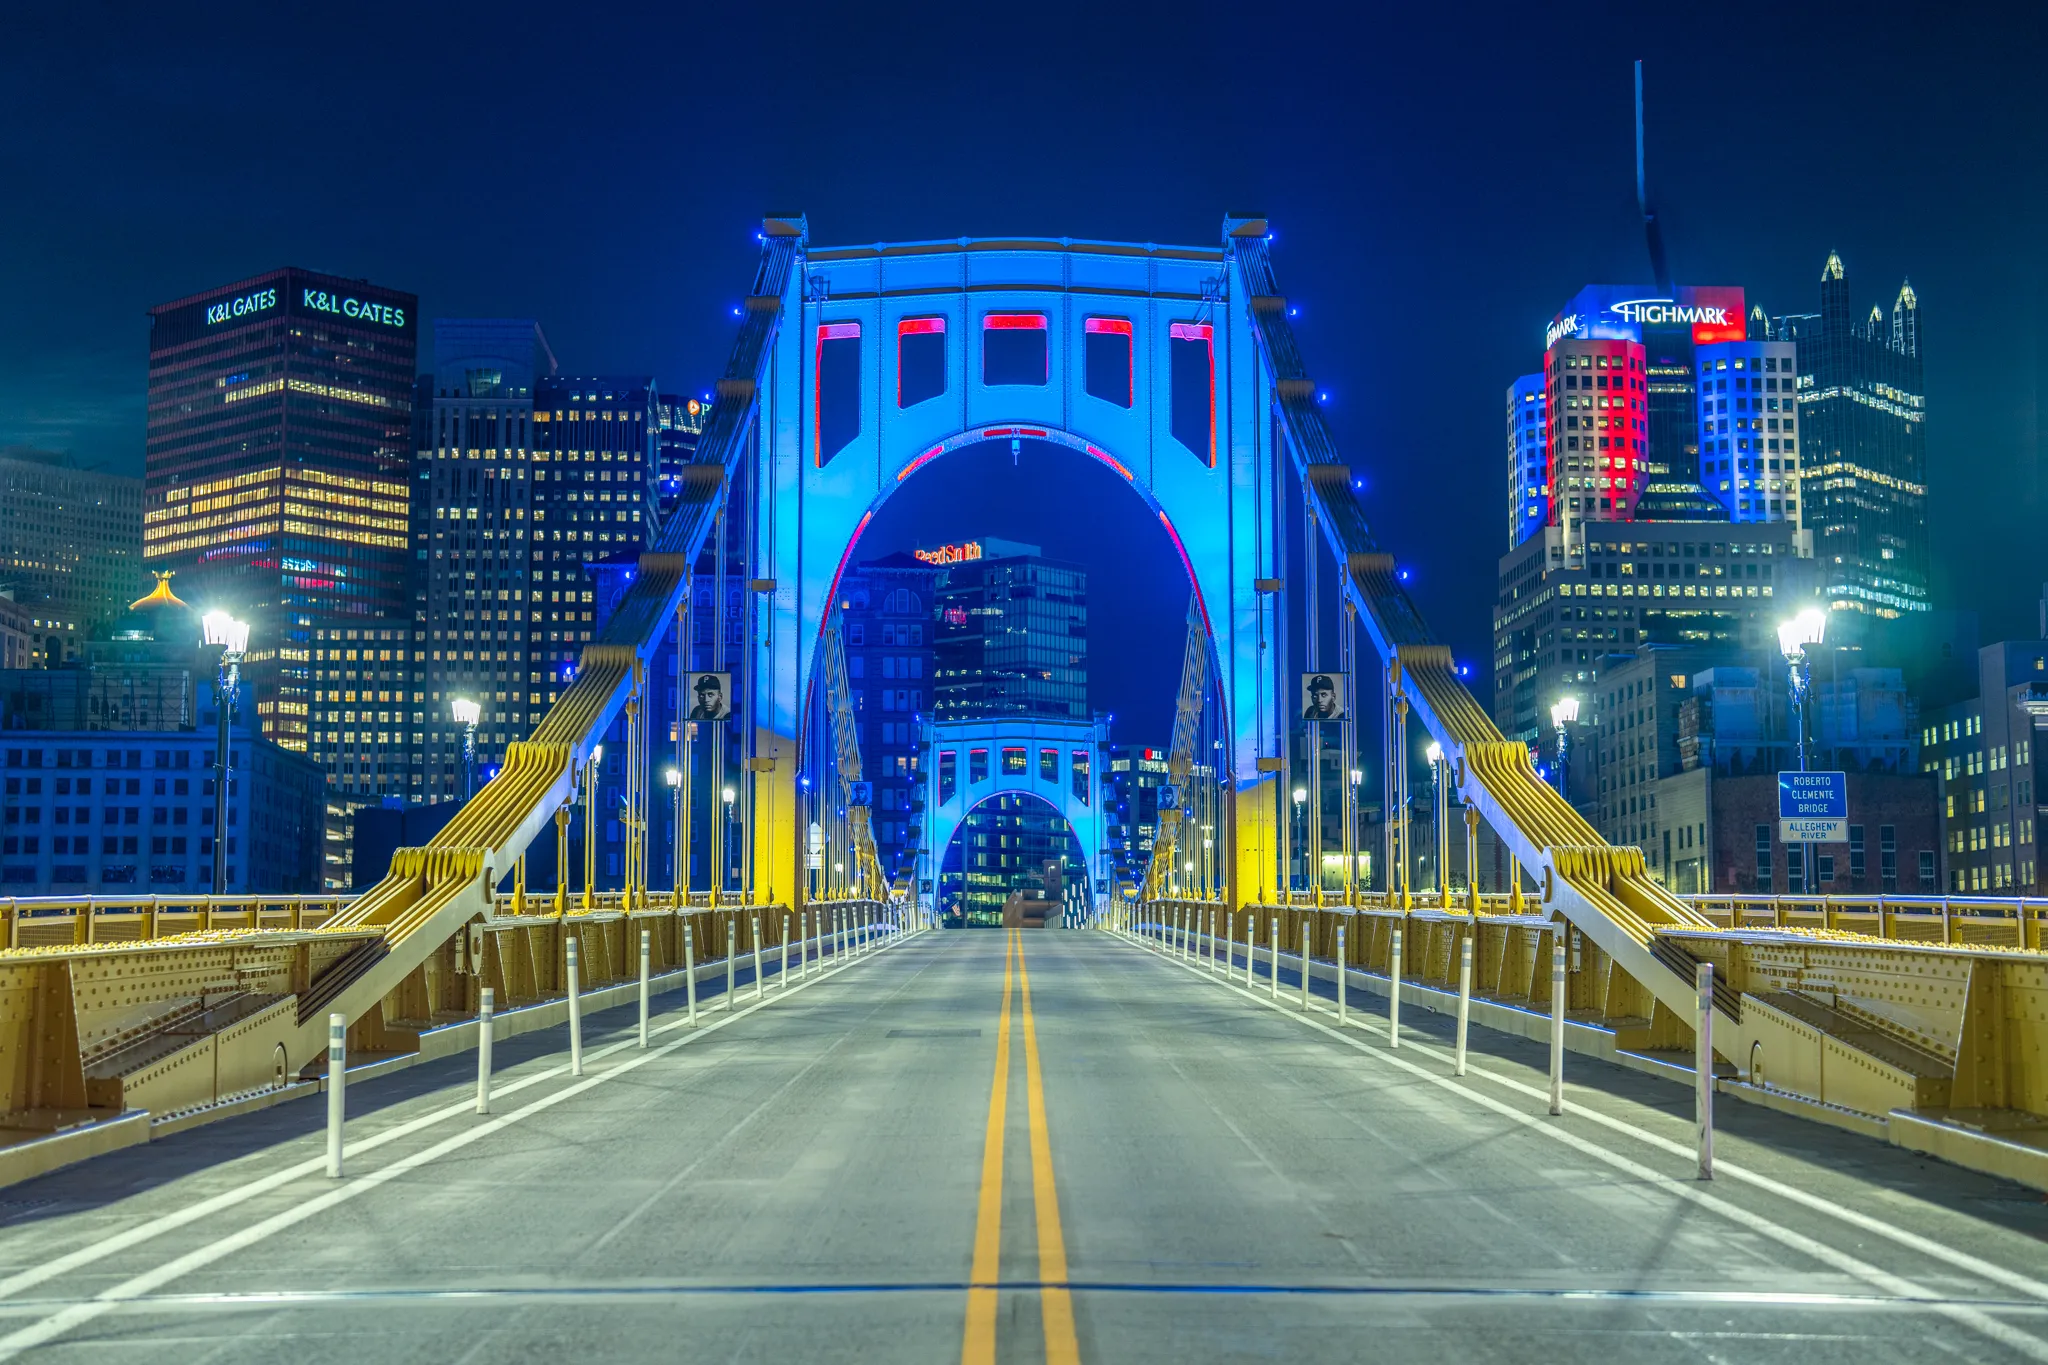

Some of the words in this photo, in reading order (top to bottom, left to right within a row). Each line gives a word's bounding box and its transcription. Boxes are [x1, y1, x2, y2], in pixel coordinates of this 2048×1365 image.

[207, 302, 232, 325] K&L
[233, 288, 276, 316] GATES
[304, 288, 340, 314] K&L
[343, 297, 405, 327] GATES
[1612, 301, 1727, 326] HIGHMARK
[1793, 776, 1831, 786] ROBERTO
[1791, 790, 1835, 800] CLEMENTE
[1798, 803, 1829, 813] BRIDGE
[1789, 822, 1838, 832] ALLEGHENY
